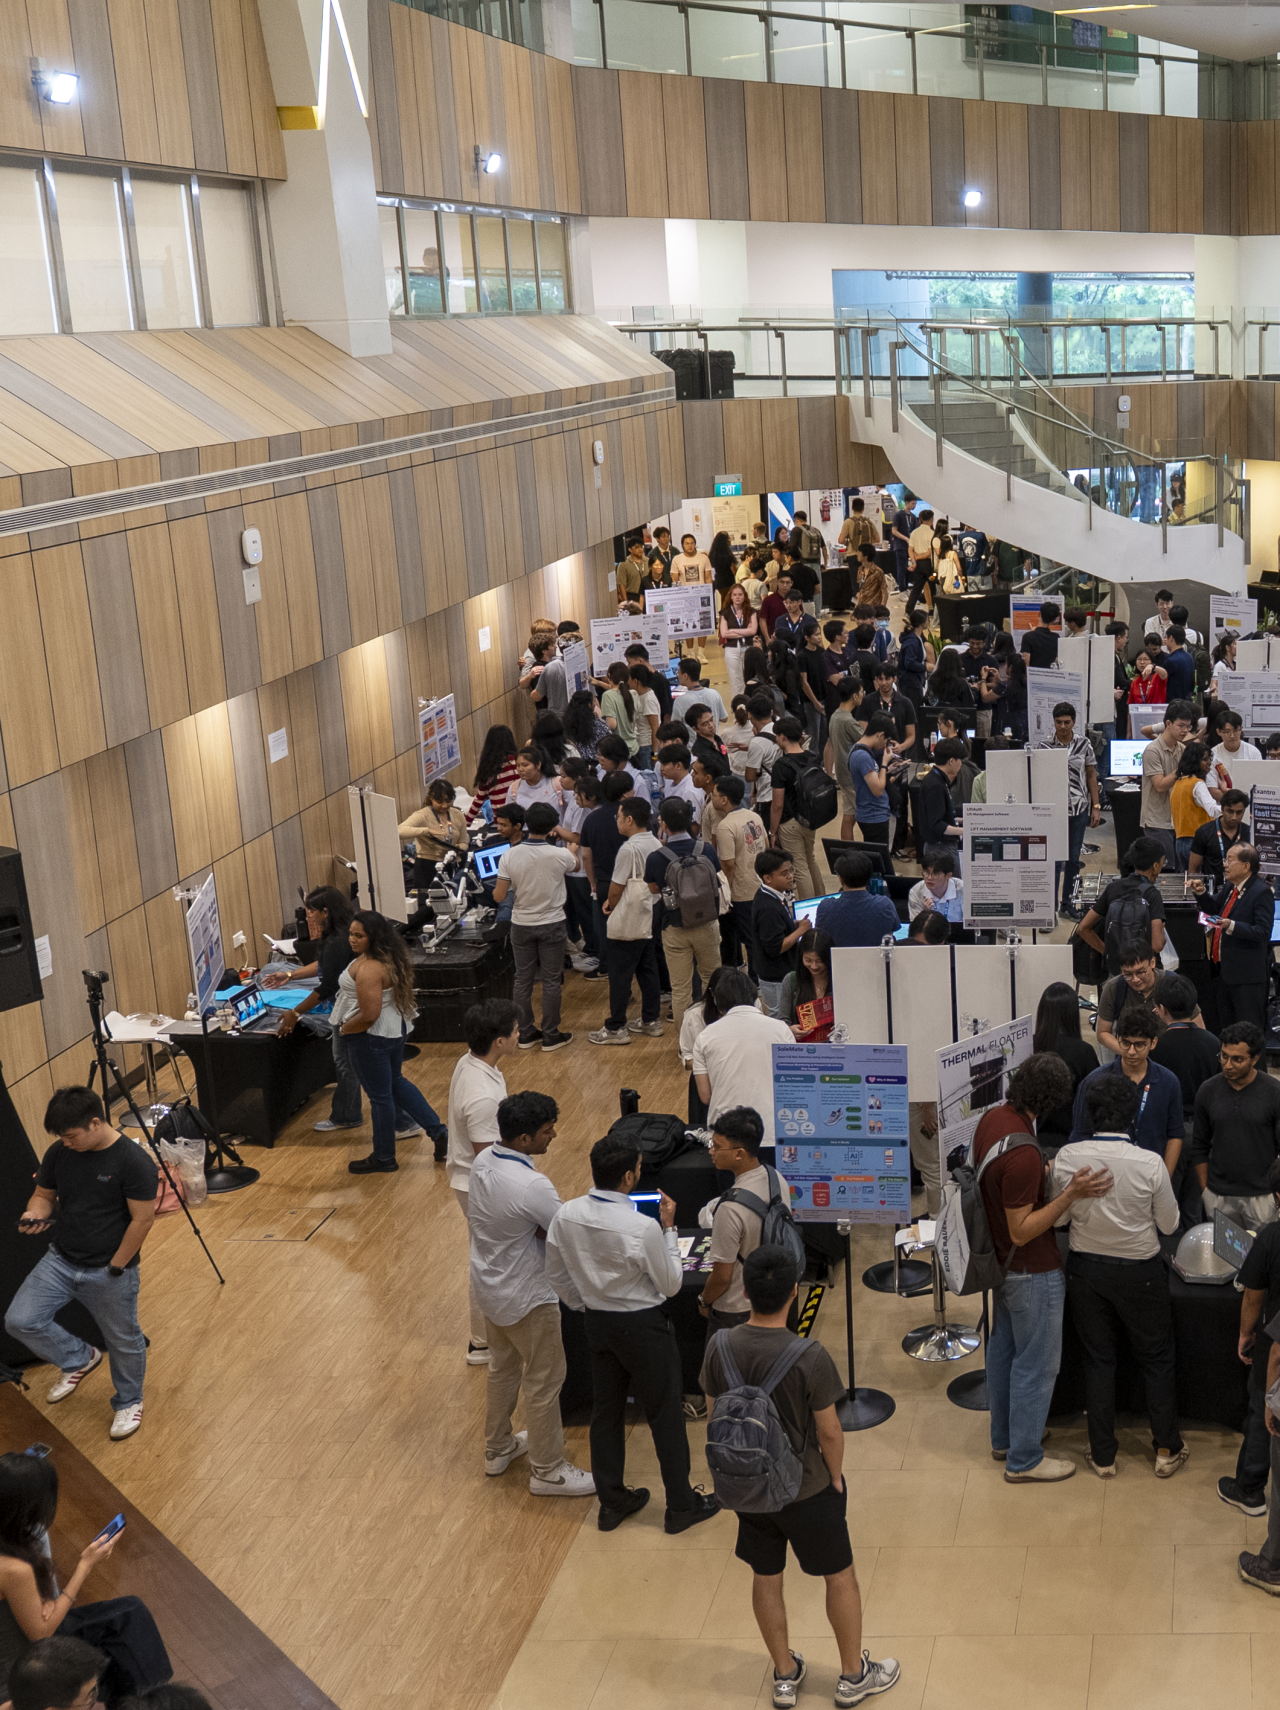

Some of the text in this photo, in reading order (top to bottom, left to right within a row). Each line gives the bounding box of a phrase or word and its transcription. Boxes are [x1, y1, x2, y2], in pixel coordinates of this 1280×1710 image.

[720, 484, 736, 496] EXIT
[941, 1028, 1028, 1069] THERMAL FLOATER
